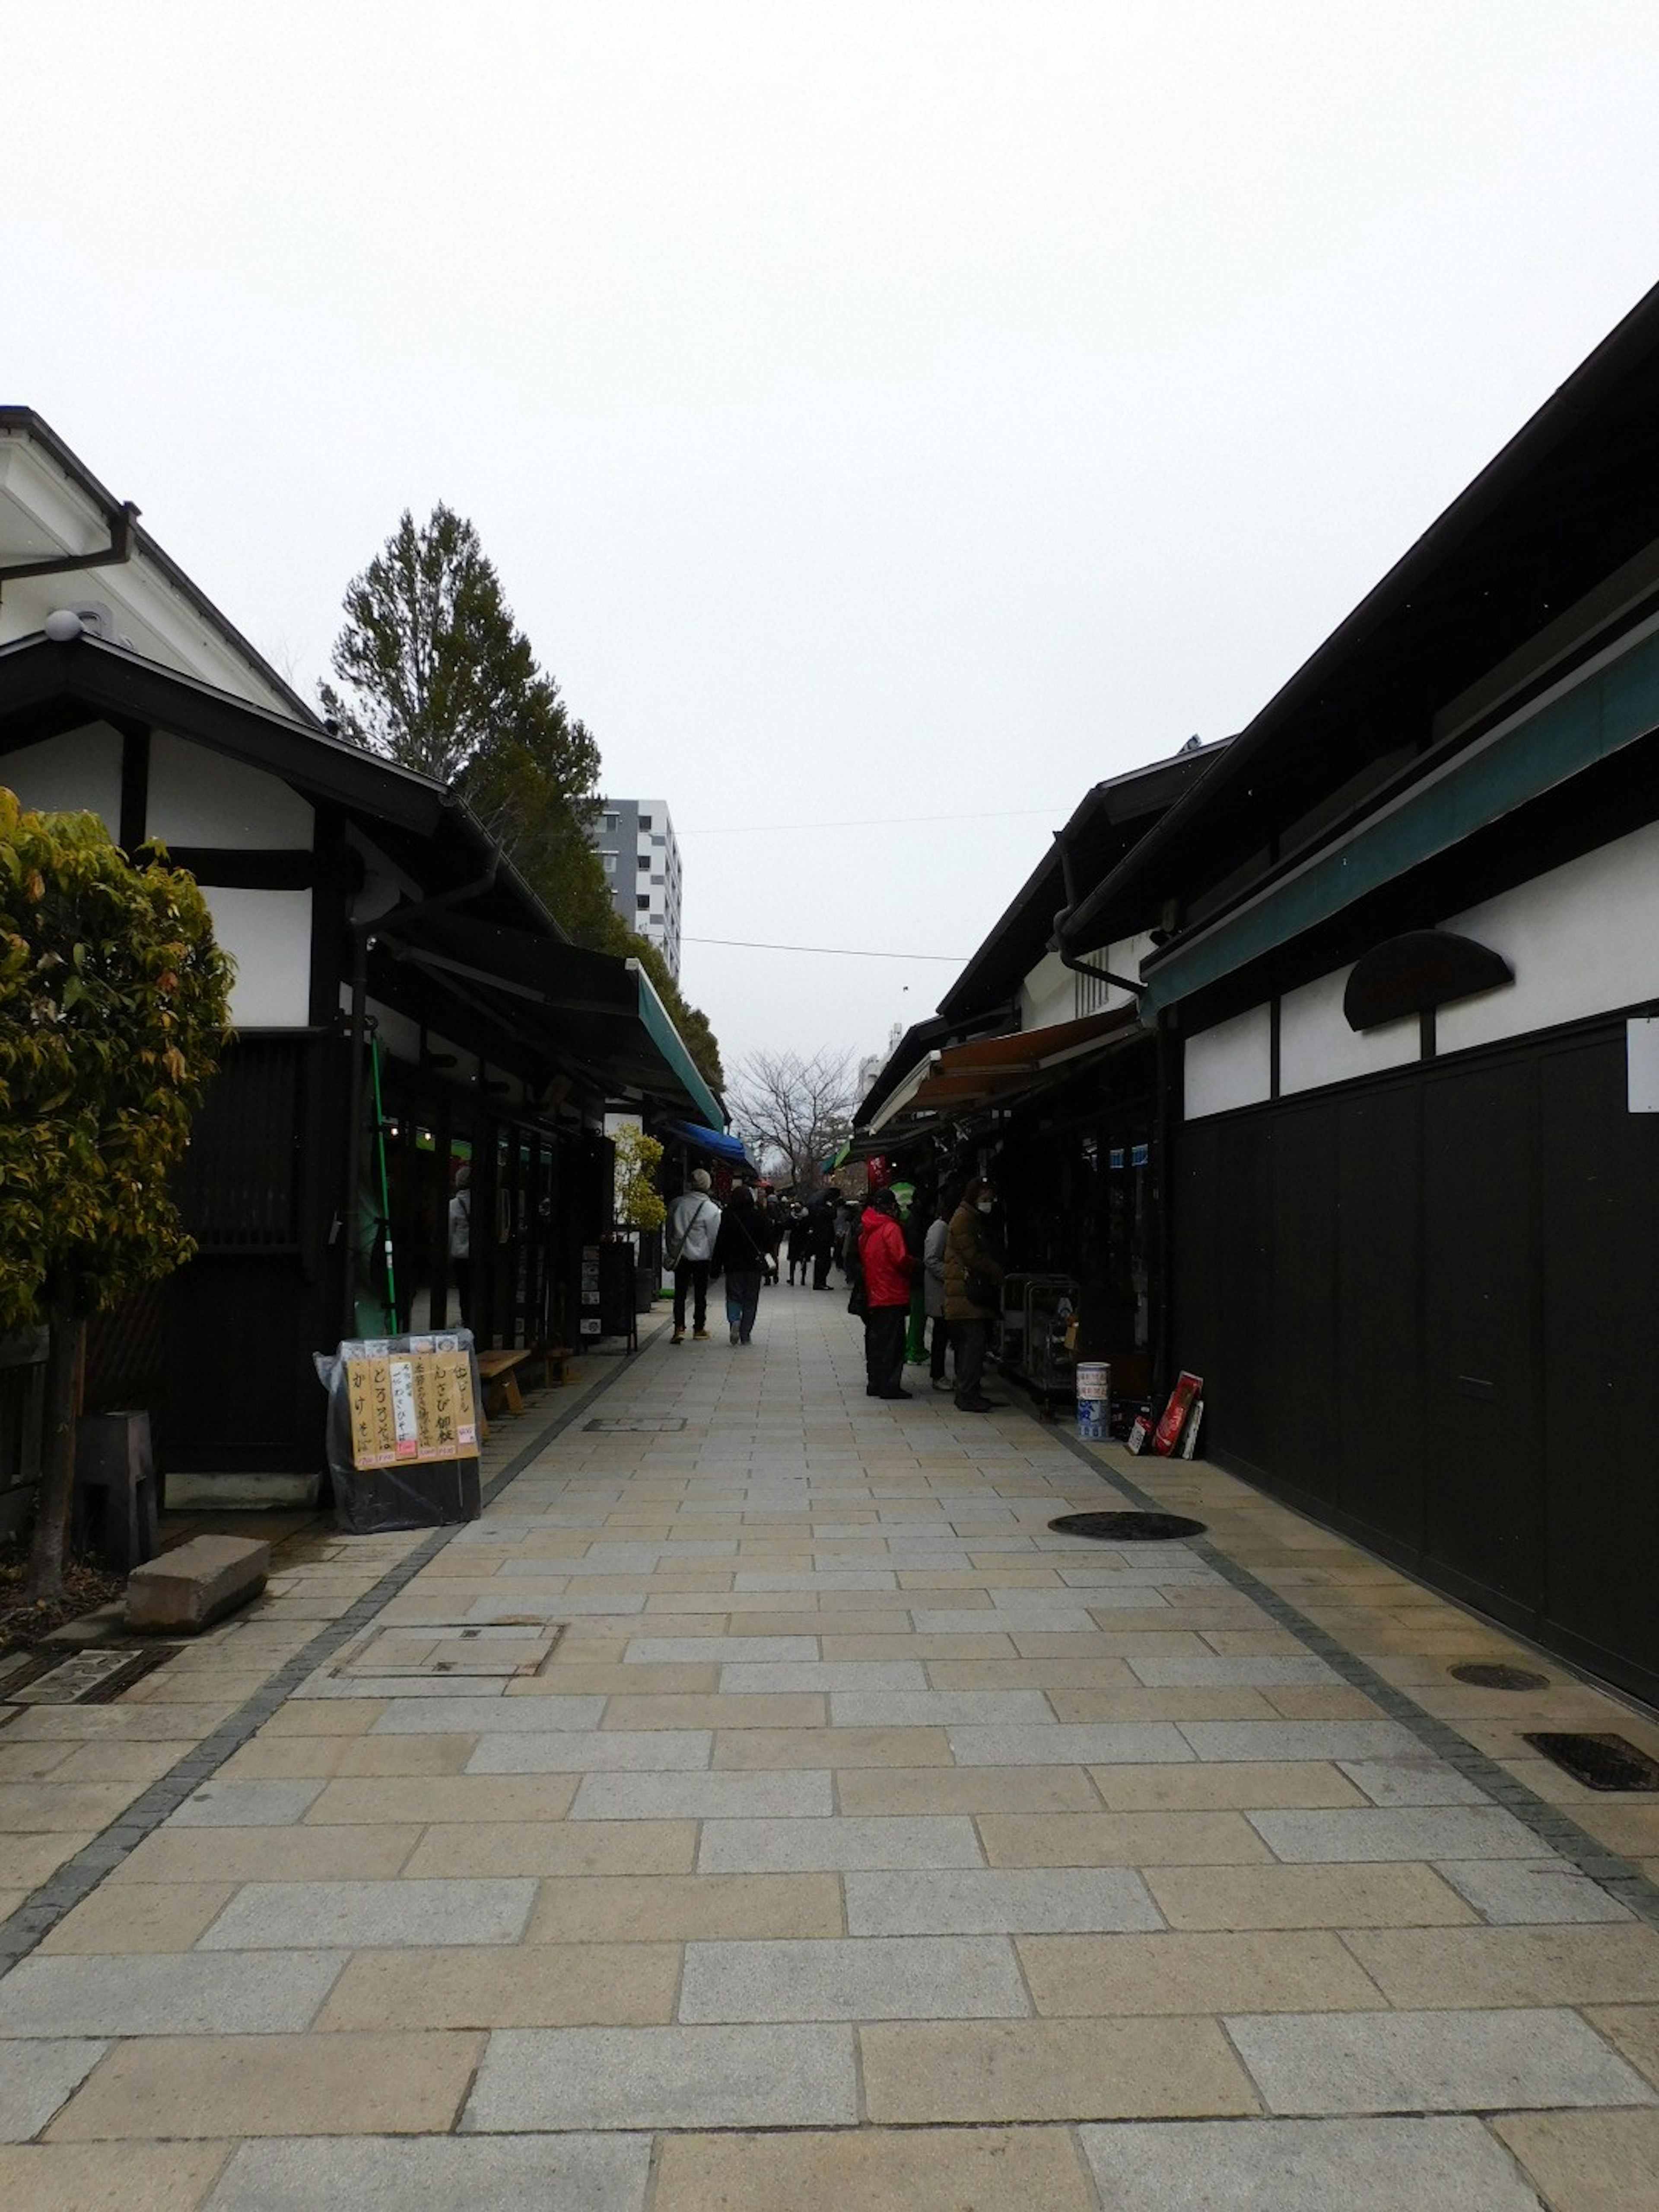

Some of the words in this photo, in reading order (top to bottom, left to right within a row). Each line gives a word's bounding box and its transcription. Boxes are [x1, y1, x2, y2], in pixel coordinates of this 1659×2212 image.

[353, 1373, 372, 1452] かけそば
[375, 1370, 395, 1449] とろろそば
